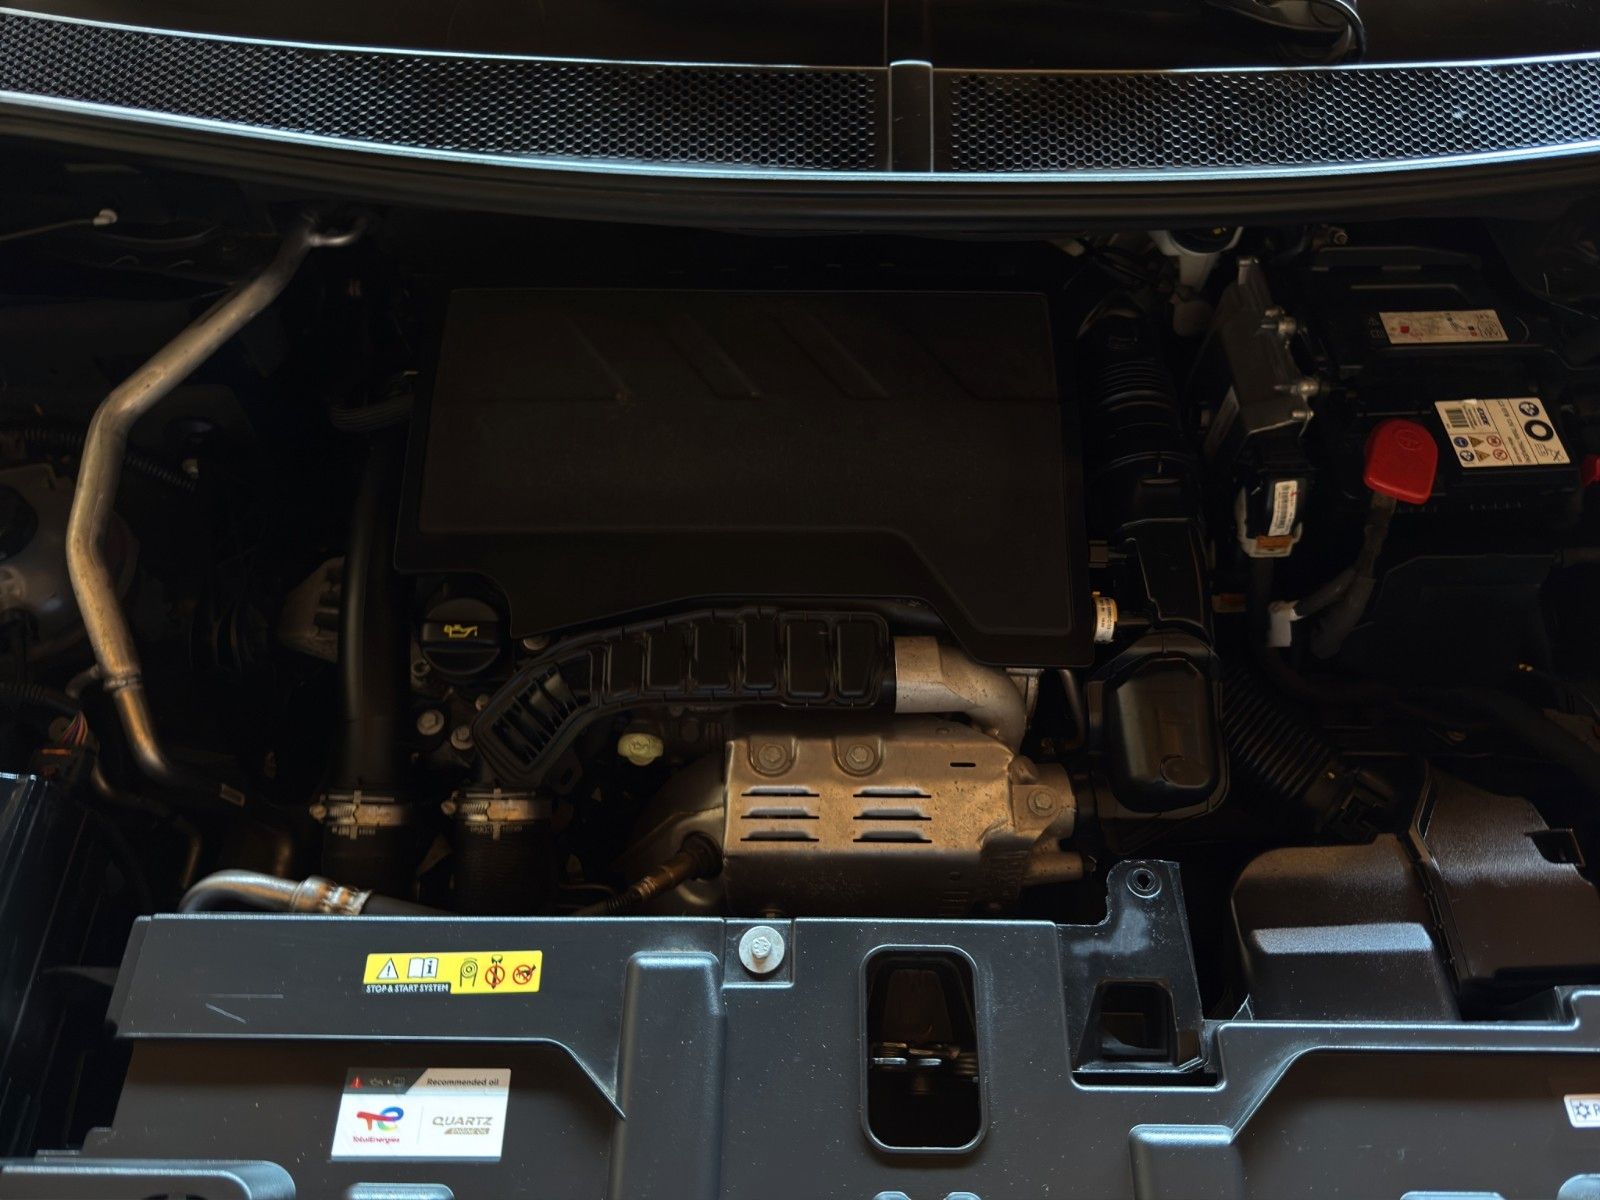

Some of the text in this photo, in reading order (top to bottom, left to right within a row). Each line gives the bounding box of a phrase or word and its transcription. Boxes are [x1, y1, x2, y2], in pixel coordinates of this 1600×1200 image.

[366, 983, 449, 993] STOP & START SYSTEM
[427, 1078, 499, 1087] Recommended oil
[432, 1116, 493, 1126] QUARTZ
